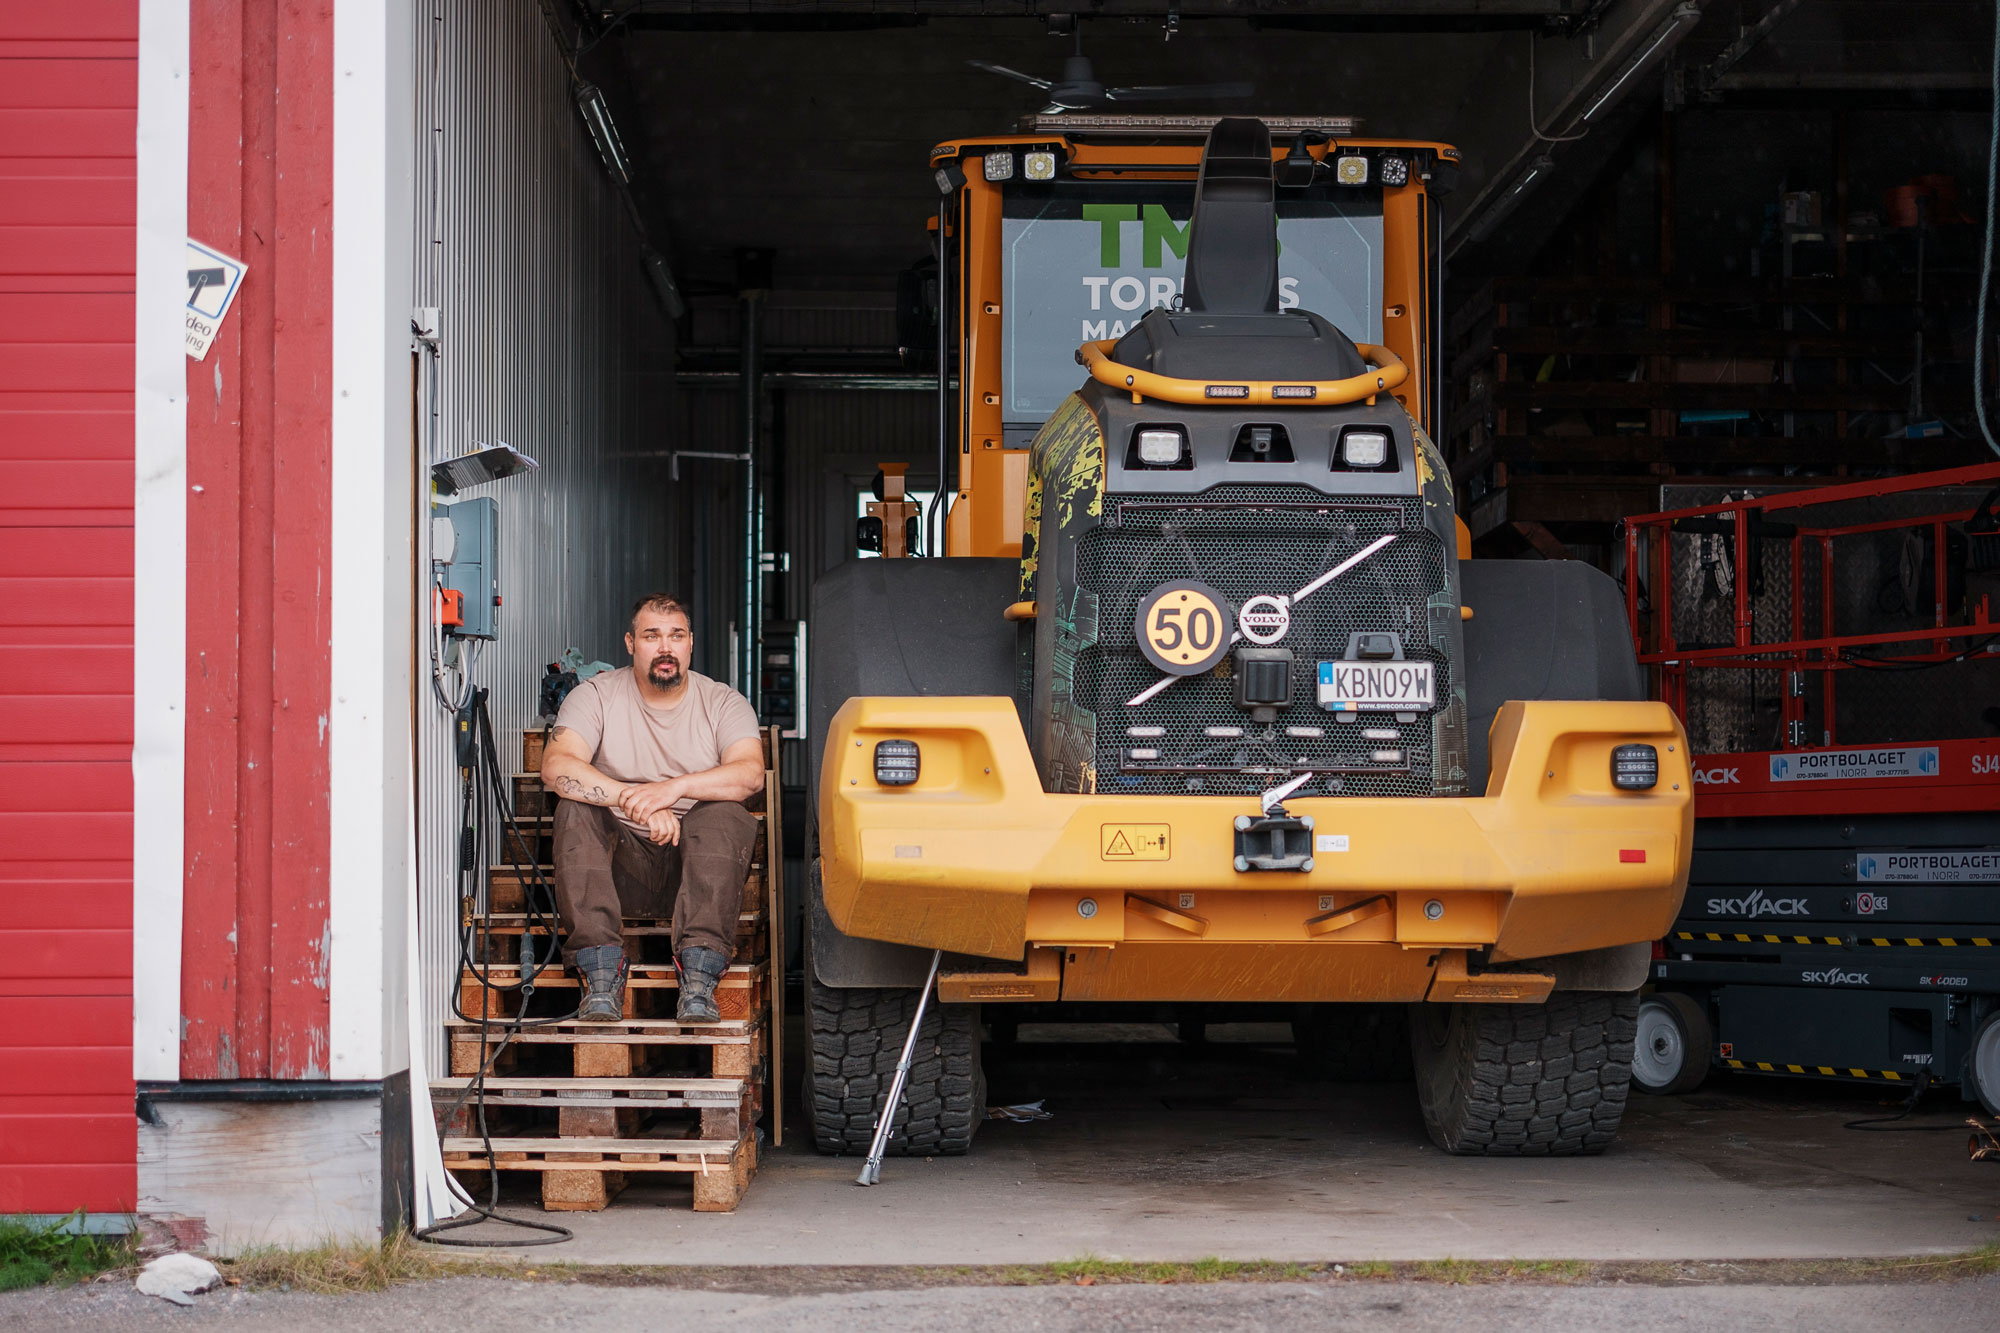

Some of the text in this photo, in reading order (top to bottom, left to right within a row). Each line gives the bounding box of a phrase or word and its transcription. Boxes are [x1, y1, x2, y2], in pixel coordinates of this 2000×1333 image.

[1243, 616, 1287, 624] VOLVO
[1154, 607, 1215, 651] 50
[1336, 668, 1428, 698] KBN09W
[1357, 702, 1421, 710] www.swecon.com
[1800, 751, 1906, 768] PORTBOLAGET
[1841, 768, 1867, 778] NORR
[1889, 855, 2000, 869] PORTBOLAGET
[1932, 871, 1960, 880] NORR
[1707, 889, 1810, 918] SKYJACK
[1802, 967, 1870, 985] SKYJACK
